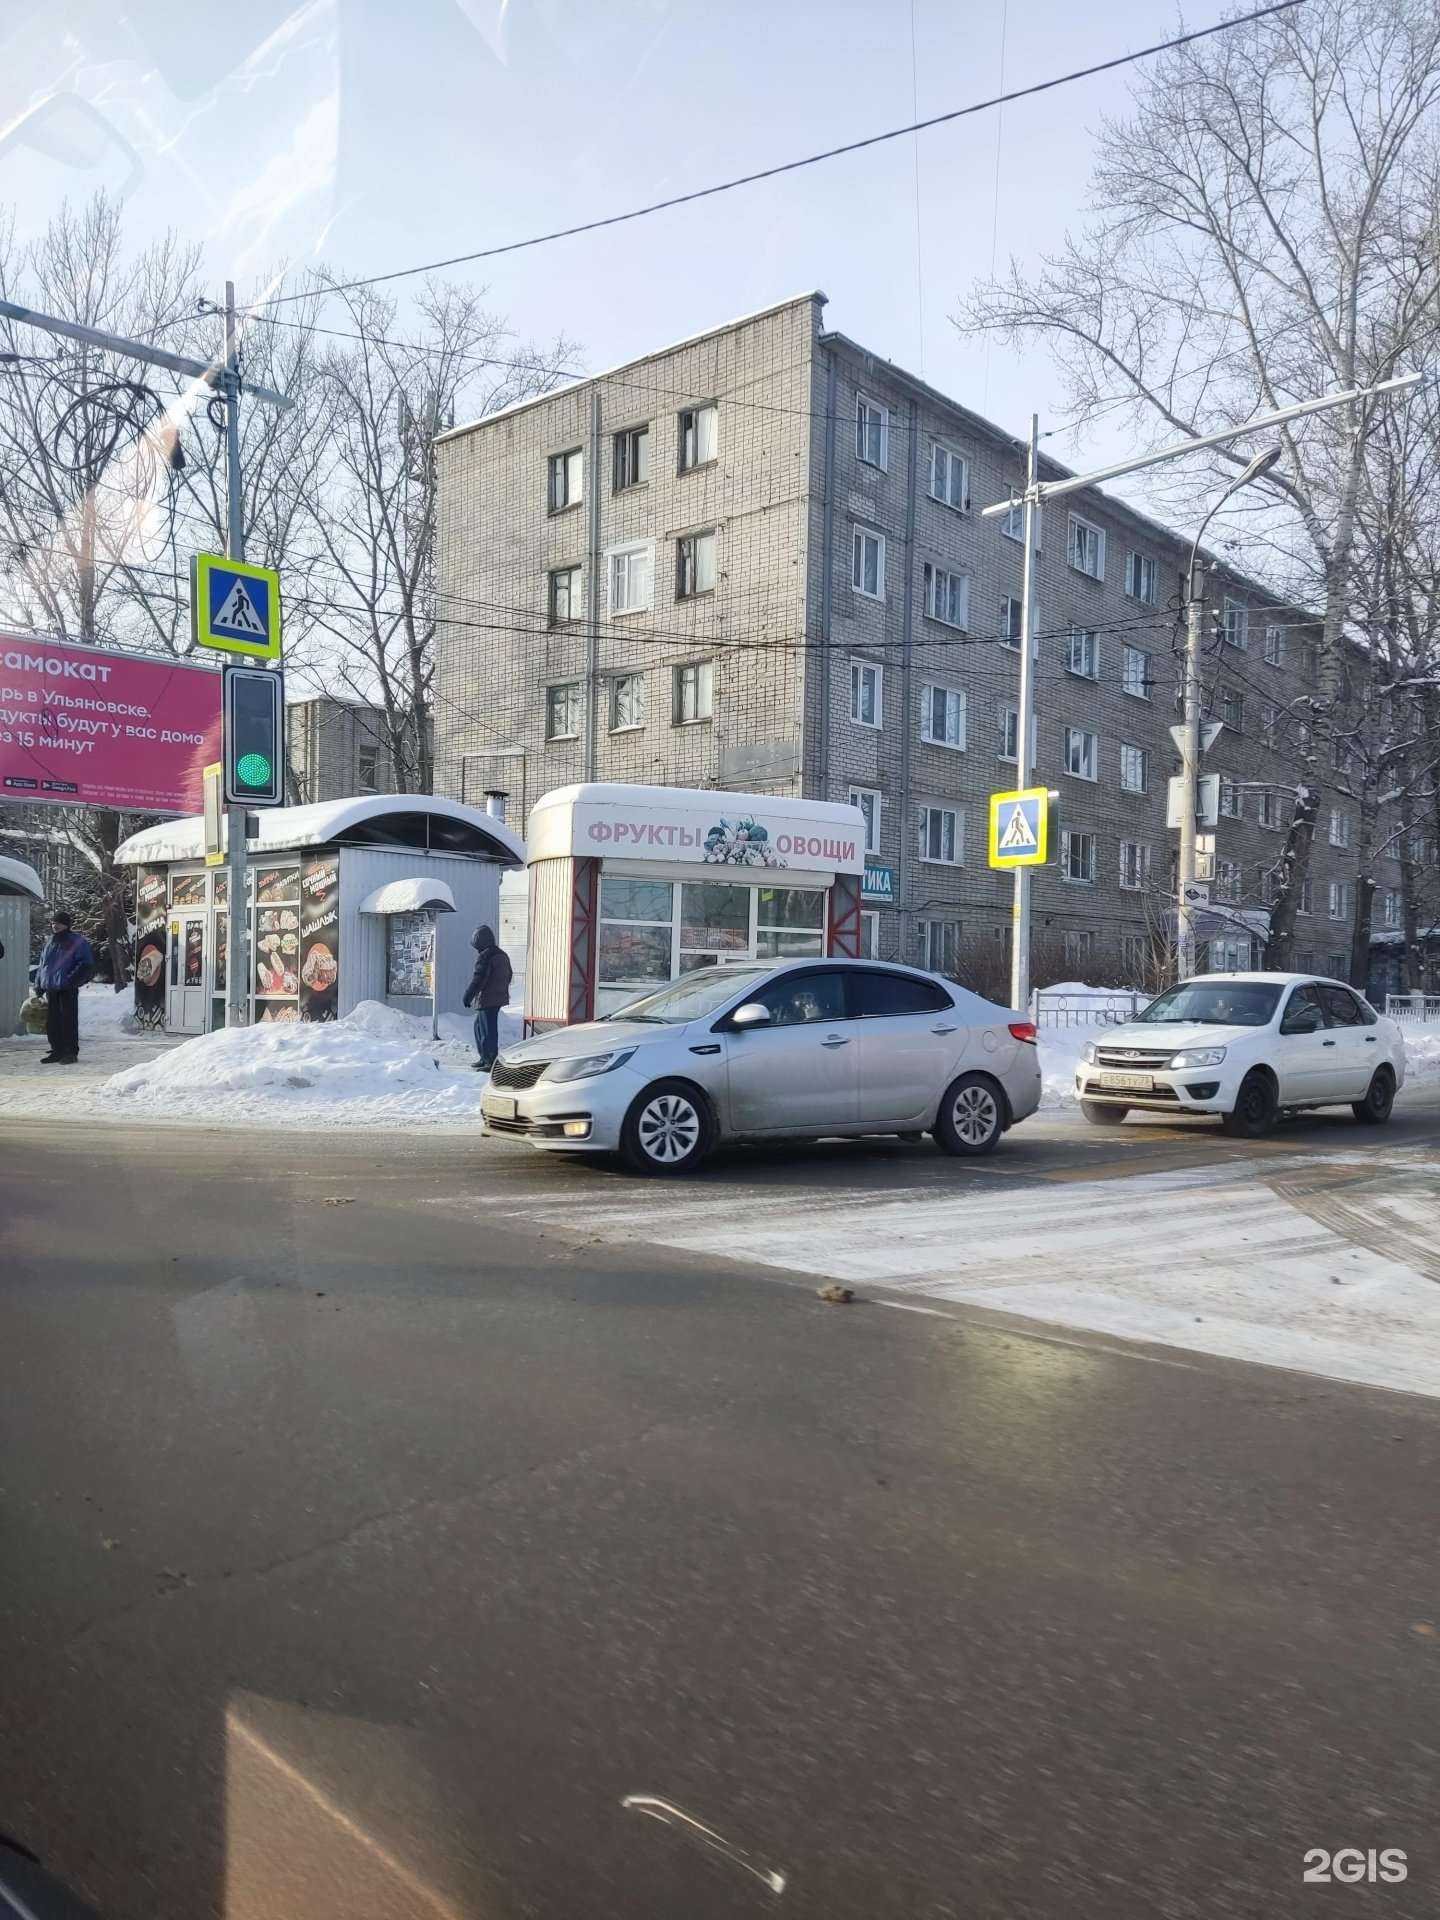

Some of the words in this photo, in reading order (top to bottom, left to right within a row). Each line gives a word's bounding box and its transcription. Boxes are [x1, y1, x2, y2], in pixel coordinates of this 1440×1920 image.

[0, 652, 111, 682] амокат
[27, 691, 38, 702] в
[17, 731, 34, 747] 15
[40, 736, 95, 755] минут
[57, 713, 109, 735] будут
[111, 723, 121, 738] у
[126, 725, 157, 739] вас
[160, 730, 204, 745] дома
[587, 820, 701, 848] ФРУКТЫ
[776, 834, 856, 862] ОВОЩИ
[301, 910, 338, 938] ШАШЛЫК
